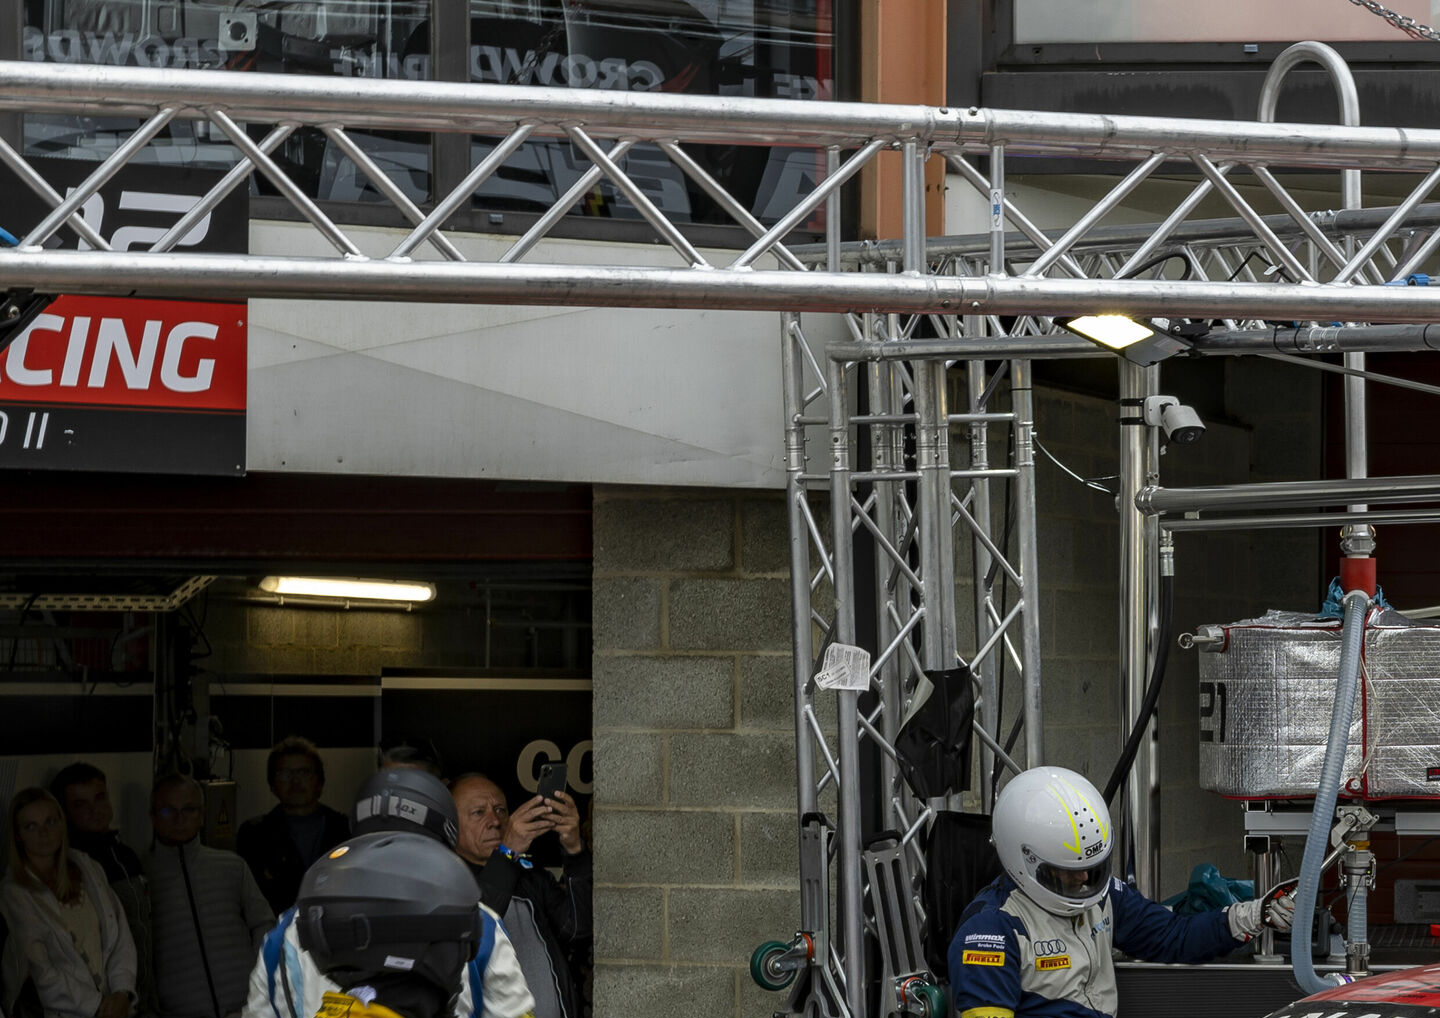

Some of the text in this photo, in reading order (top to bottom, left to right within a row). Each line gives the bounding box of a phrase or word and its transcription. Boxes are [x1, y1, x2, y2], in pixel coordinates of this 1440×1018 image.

[1085, 842, 1104, 858] OMP
[966, 953, 1001, 963] PIRELLI
[1040, 958, 1069, 968] PIRELLI
